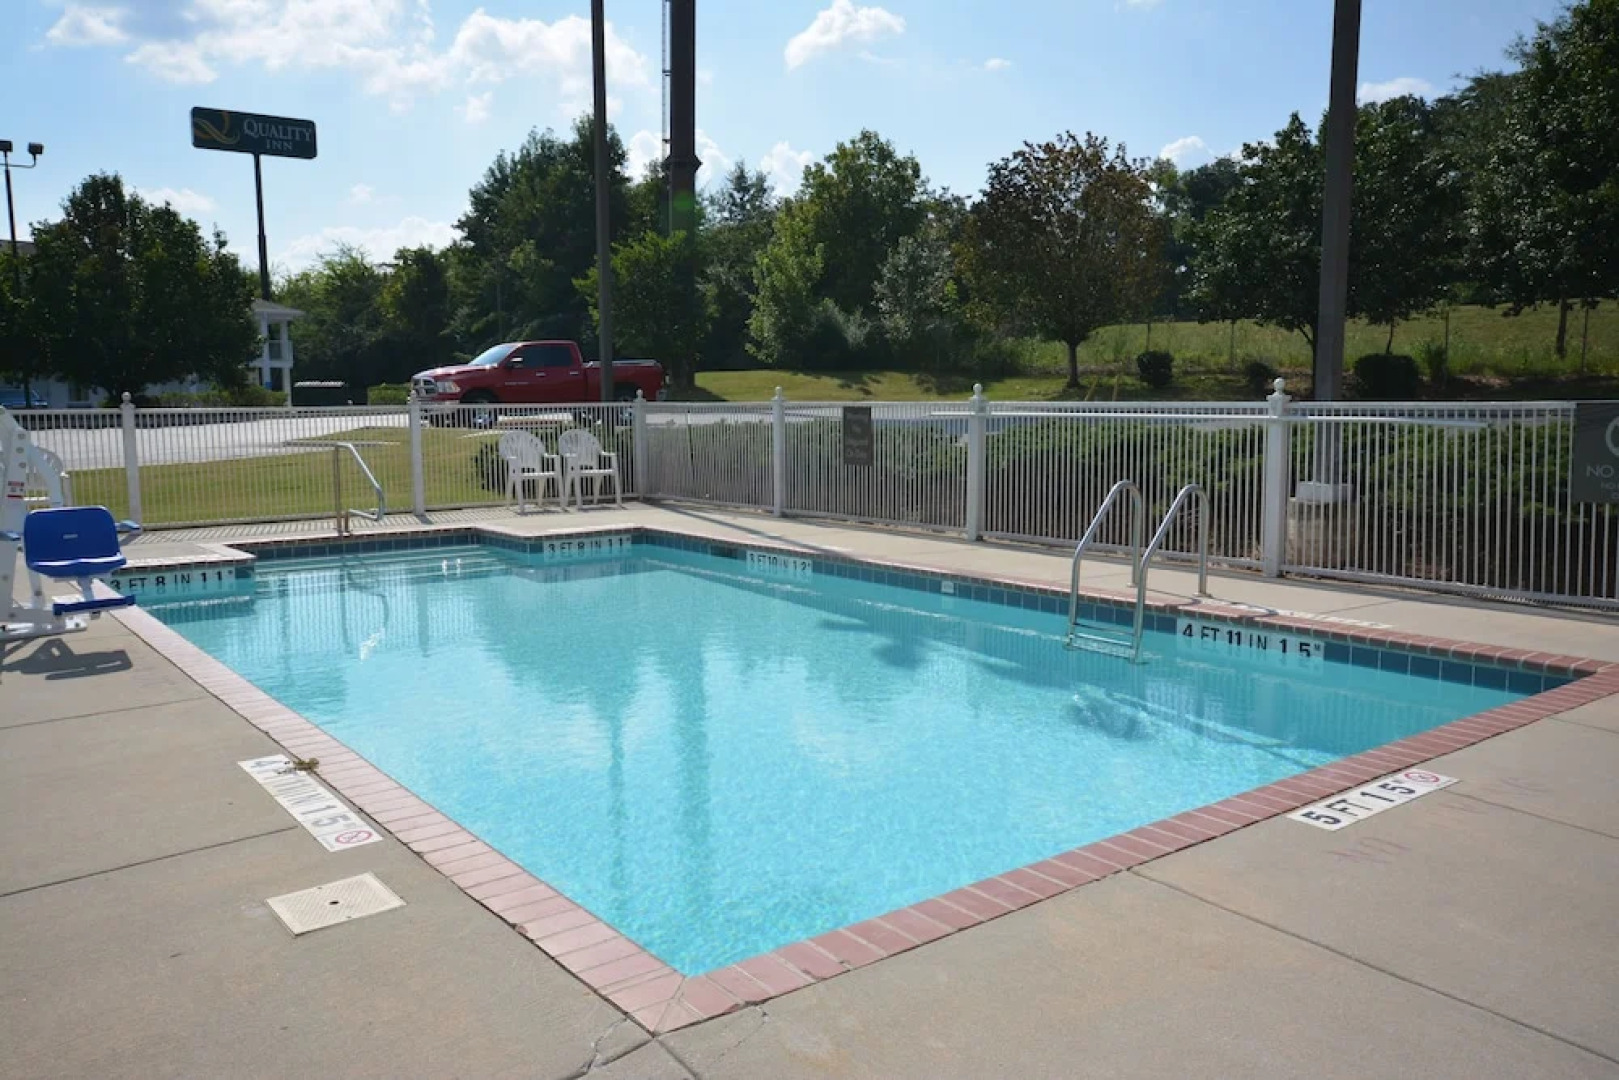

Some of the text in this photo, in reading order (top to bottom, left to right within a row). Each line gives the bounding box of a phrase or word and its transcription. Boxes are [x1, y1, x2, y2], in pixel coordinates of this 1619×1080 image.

[243, 118, 312, 142] QUALITY
[266, 140, 293, 151] INN
[1586, 464, 1615, 478] NO
[129, 577, 148, 589] FT
[155, 576, 166, 587] 8
[174, 573, 191, 585] IN
[1182, 623, 1194, 638] 4
[1201, 626, 1220, 643] FT
[1226, 629, 1243, 647] 11
[1250, 634, 1268, 651] IN
[1301, 810, 1342, 825] 5
[1325, 799, 1373, 817] FT
